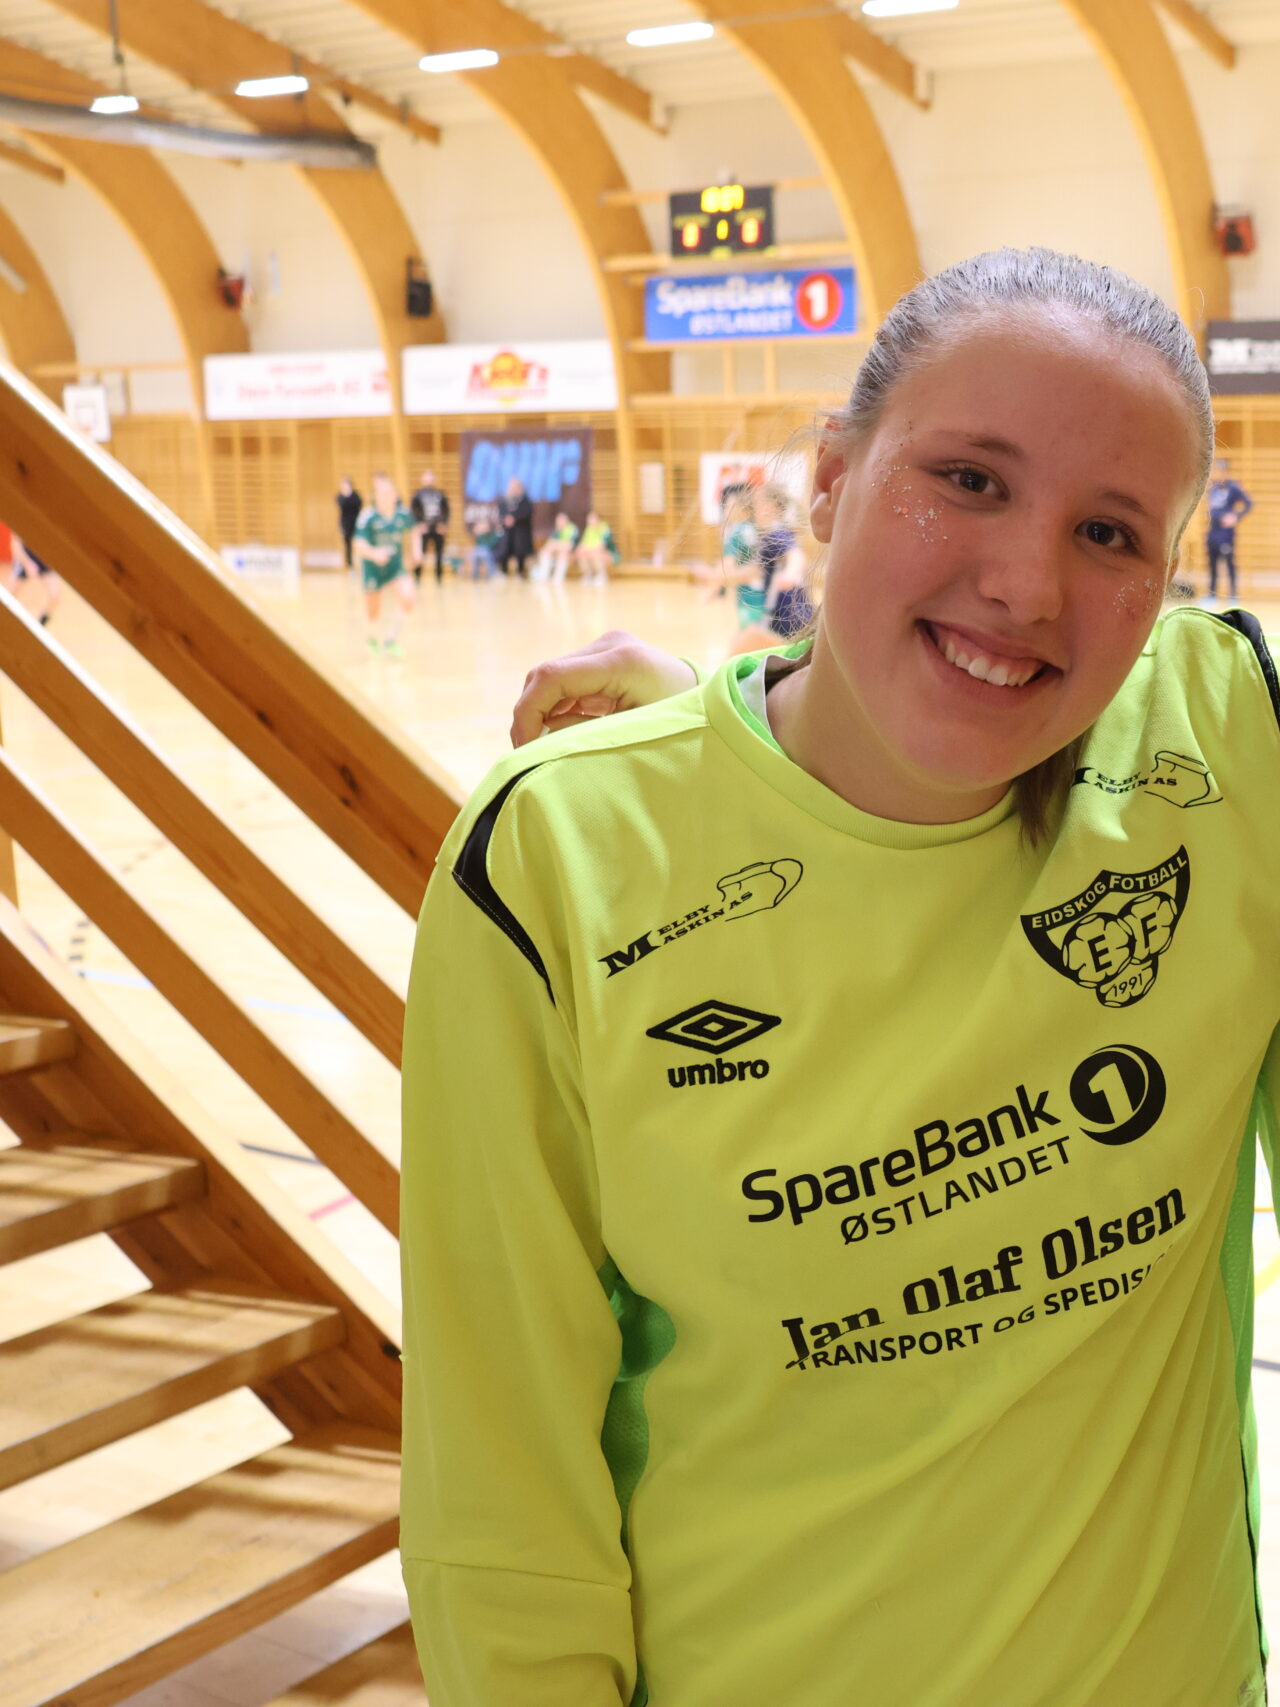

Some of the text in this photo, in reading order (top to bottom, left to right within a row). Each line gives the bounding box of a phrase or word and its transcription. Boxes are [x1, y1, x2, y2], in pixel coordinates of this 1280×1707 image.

[805, 279, 829, 322] 1
[1153, 777, 1177, 786] AS
[729, 891, 753, 910] AS
[1031, 855, 1187, 930] EIDSKOG FOTBALL
[1088, 912, 1158, 973] E F
[1111, 973, 1143, 998] 1991
[667, 1058, 770, 1088] umbro
[741, 1061, 1134, 1226] SpareBank 1
[840, 1135, 1072, 1245] ØSTLANDET
[902, 1245, 1024, 1317] Olaf
[1041, 1187, 1187, 1280] Olsen
[993, 1305, 1036, 1333] OG
[1043, 1263, 1152, 1316] SPEDIS
